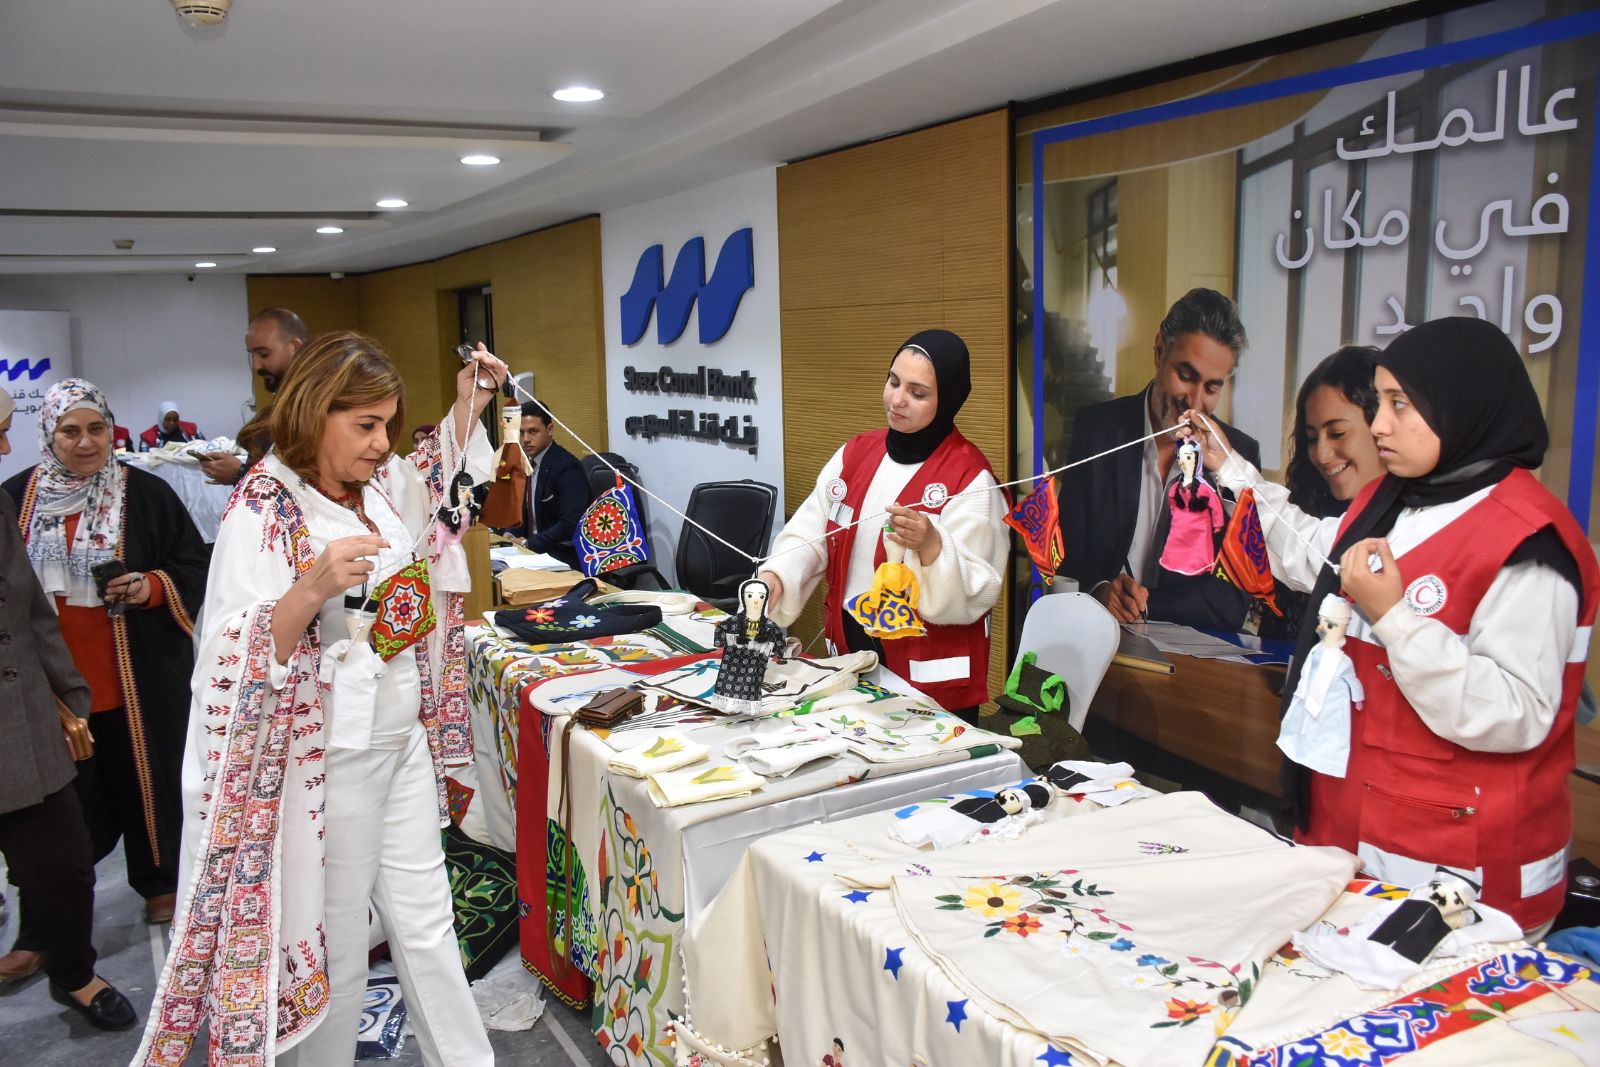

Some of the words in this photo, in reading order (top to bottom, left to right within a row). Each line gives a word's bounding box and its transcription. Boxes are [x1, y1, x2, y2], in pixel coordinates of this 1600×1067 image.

[1336, 65, 1578, 160] عالمك
[1275, 189, 1410, 269] مكان
[1435, 172, 1570, 276] في
[623, 366, 660, 392] Suez
[659, 366, 706, 395] Canal
[707, 368, 758, 401] Bank
[625, 409, 680, 439] السويس
[719, 415, 758, 455] بنك
